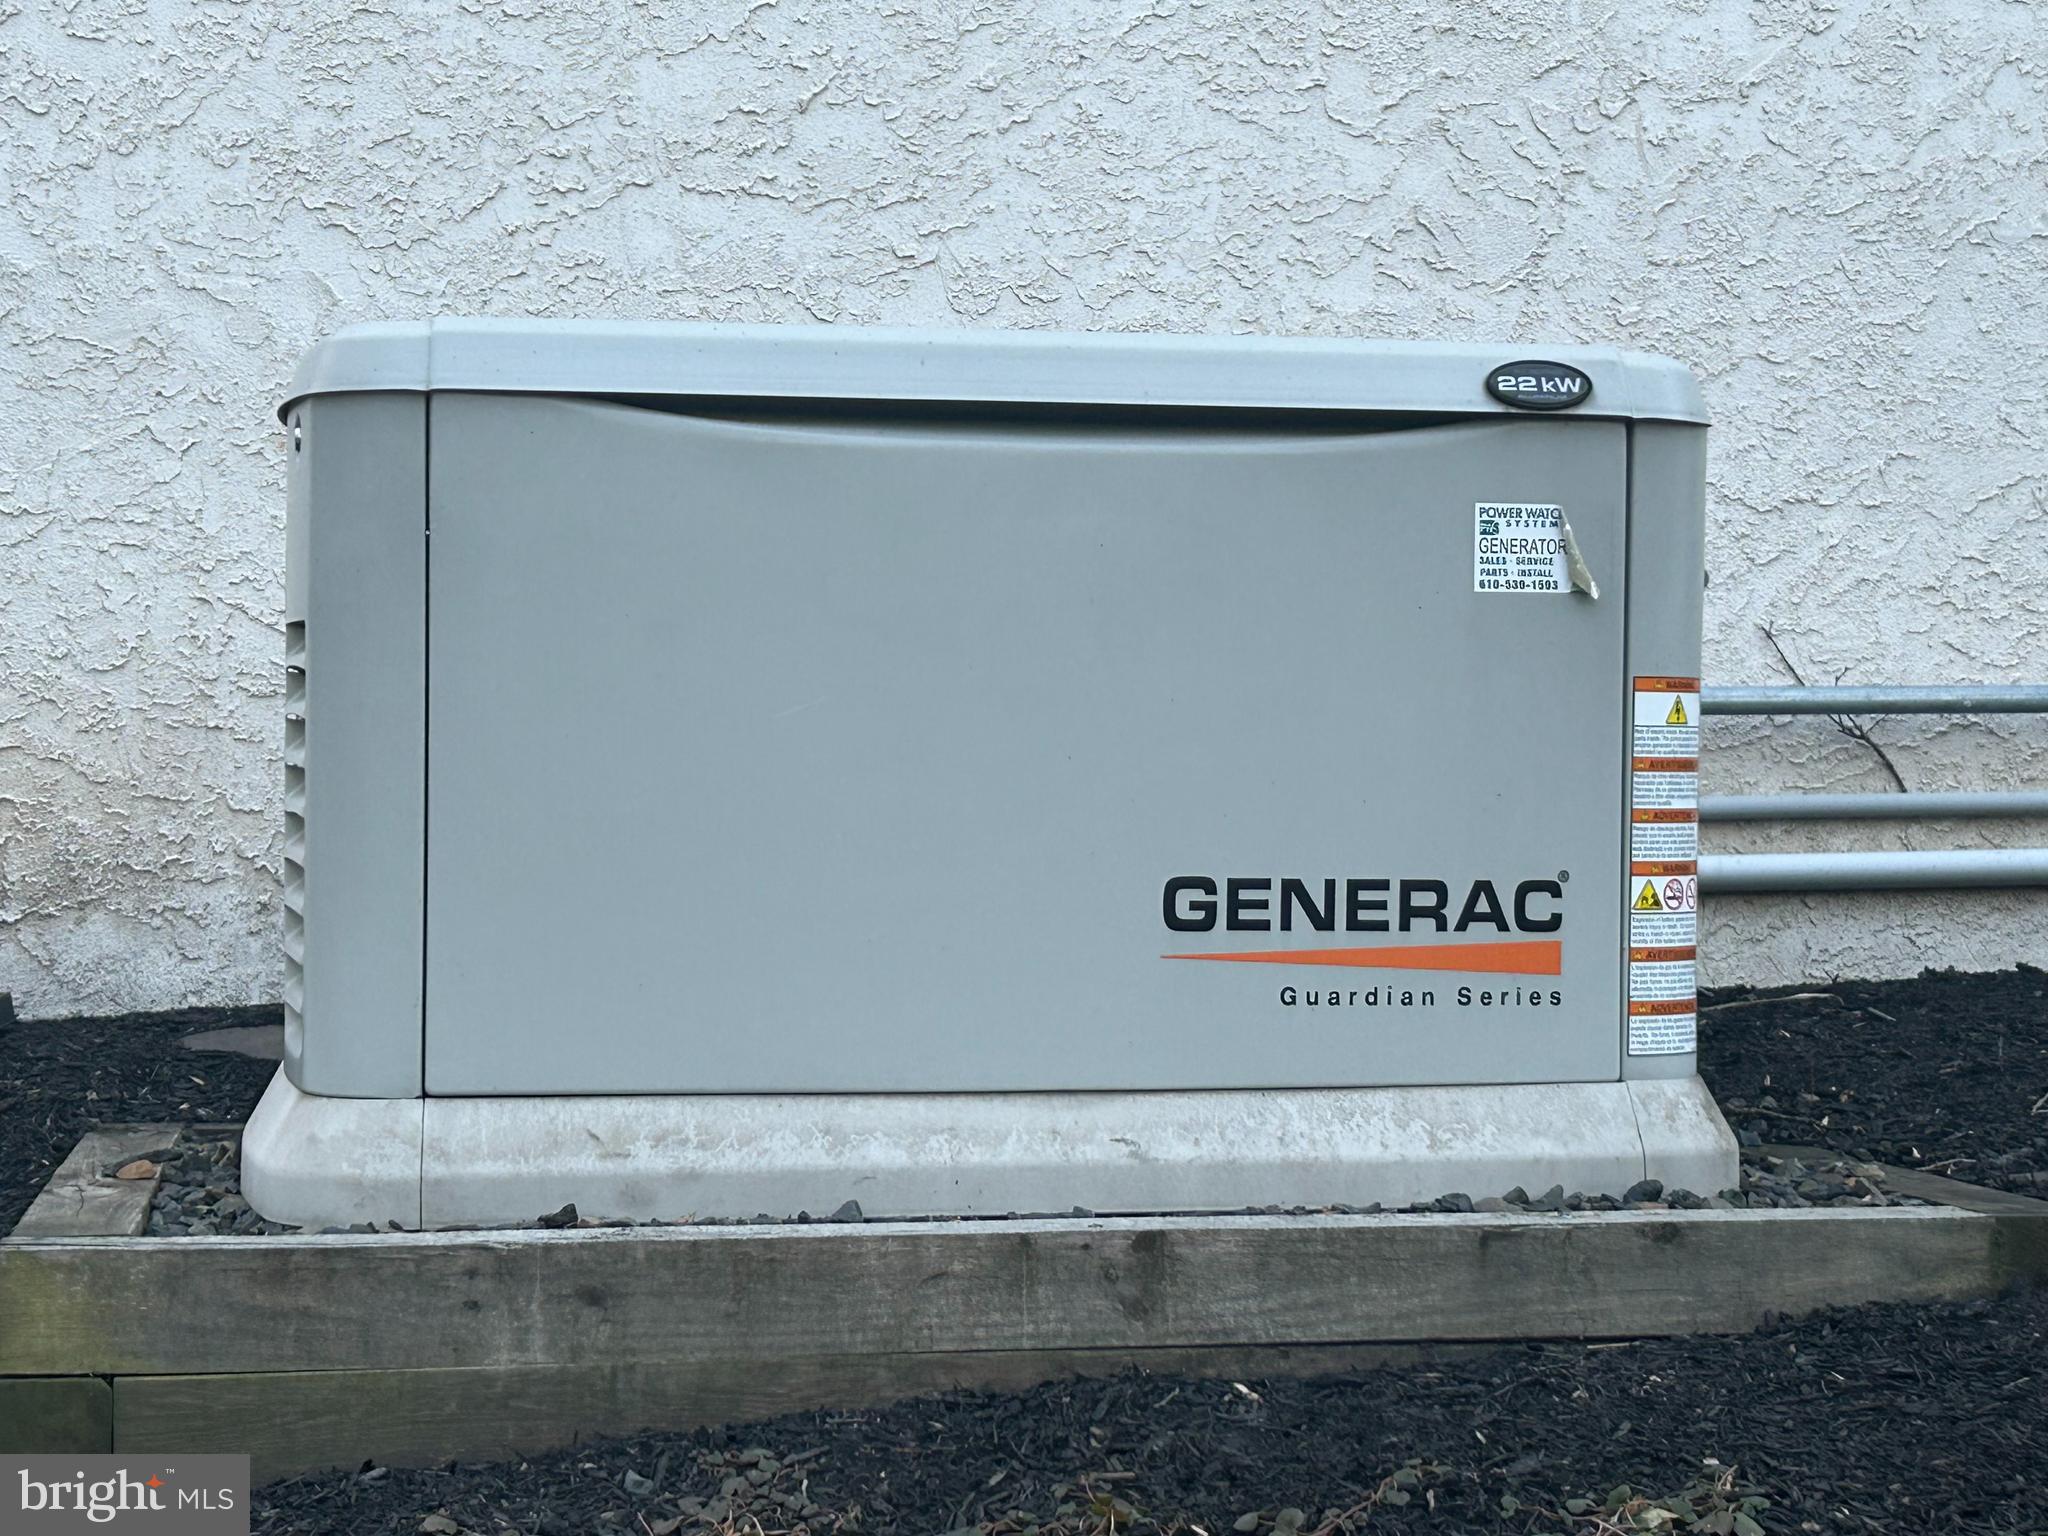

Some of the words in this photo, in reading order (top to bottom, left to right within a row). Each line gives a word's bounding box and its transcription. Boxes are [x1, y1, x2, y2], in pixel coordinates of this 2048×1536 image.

[1497, 375, 1538, 391] 22
[1479, 506, 1523, 519] POWER
[1505, 520, 1559, 528] SYSTEM
[1478, 537, 1568, 555] GENERATOR
[1479, 556, 1507, 565] SALES
[1515, 556, 1554, 566] SERVICE
[1480, 568, 1508, 577] PARTS
[1517, 568, 1554, 578] INSTALL
[1162, 876, 1563, 933] GENERAC
[1279, 986, 1436, 1007] Guardian
[1457, 986, 1562, 1007] Series
